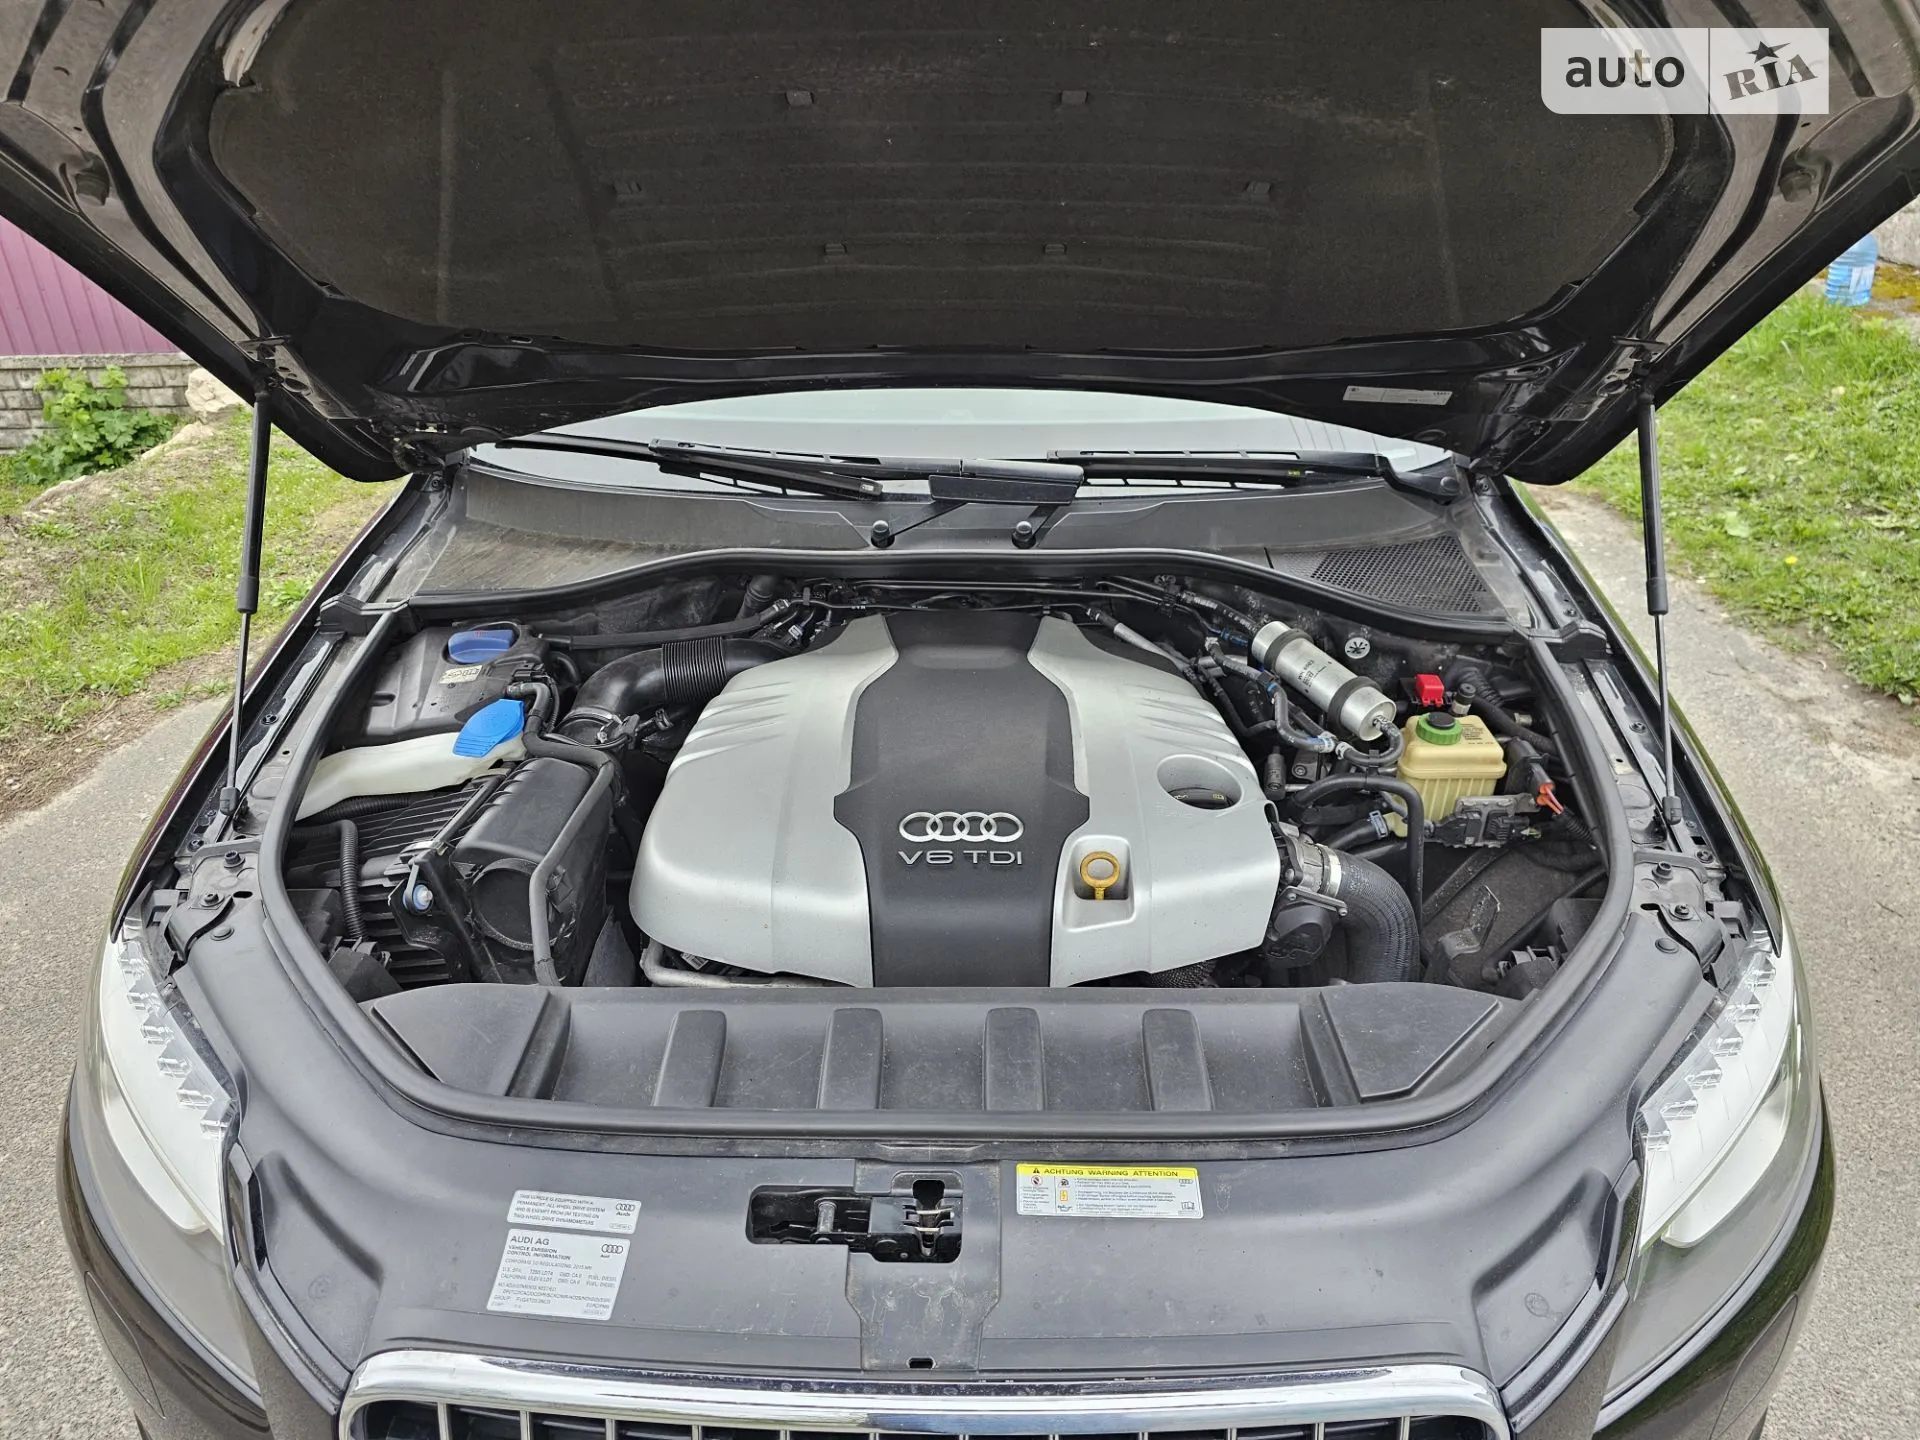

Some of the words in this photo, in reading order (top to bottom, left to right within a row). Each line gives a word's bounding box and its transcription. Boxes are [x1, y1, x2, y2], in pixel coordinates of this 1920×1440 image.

[898, 850, 954, 866] V6
[963, 850, 1023, 866] TDI
[510, 1236, 534, 1244] AUDI
[535, 1238, 550, 1246] AG
[533, 1252, 571, 1260] INFORMATION
